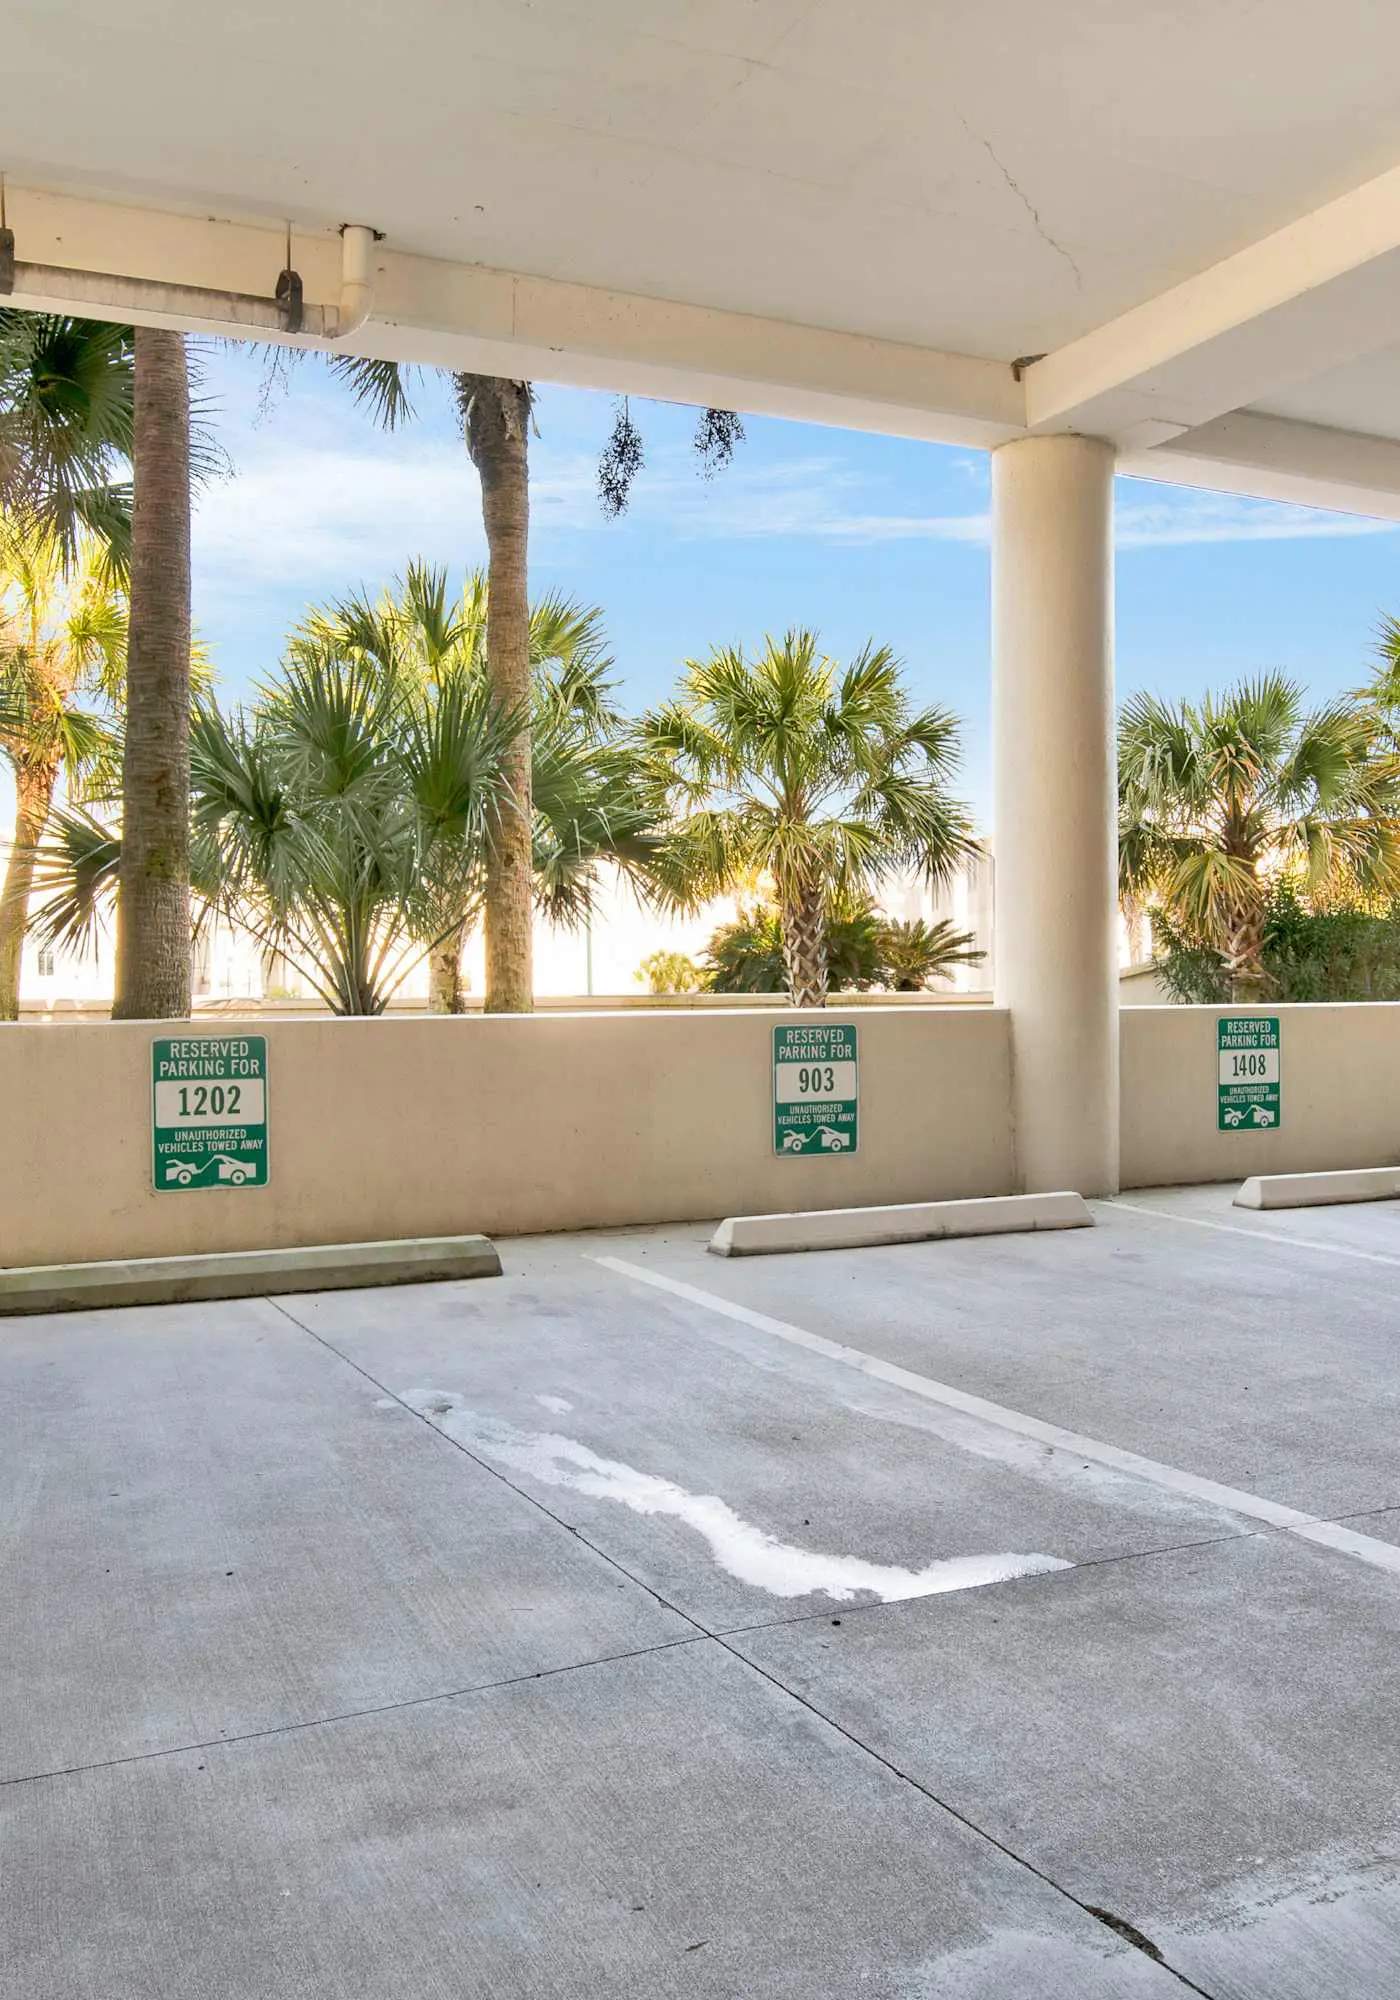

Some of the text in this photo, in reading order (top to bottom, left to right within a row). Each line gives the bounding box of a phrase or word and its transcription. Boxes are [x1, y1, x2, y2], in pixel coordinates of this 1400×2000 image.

[1227, 1021, 1271, 1034] RESERVED
[787, 1030, 844, 1043] RESERVED
[1221, 1034, 1277, 1048] PARKING FOR
[170, 1042, 248, 1058] RESERVED
[779, 1044, 852, 1060] PARKING FOR
[160, 1059, 259, 1077] PARKING FOR
[1233, 1054, 1266, 1076] 1408
[799, 1067, 834, 1093] 903
[178, 1085, 241, 1116] 1202
[790, 1104, 843, 1114] UNAUTHORIZED
[778, 1113, 855, 1124] VEHICLES TOWED AWAY
[175, 1129, 247, 1141] UNAUTHORIZED
[158, 1140, 264, 1153] VEHICLES TOWED AWAY
